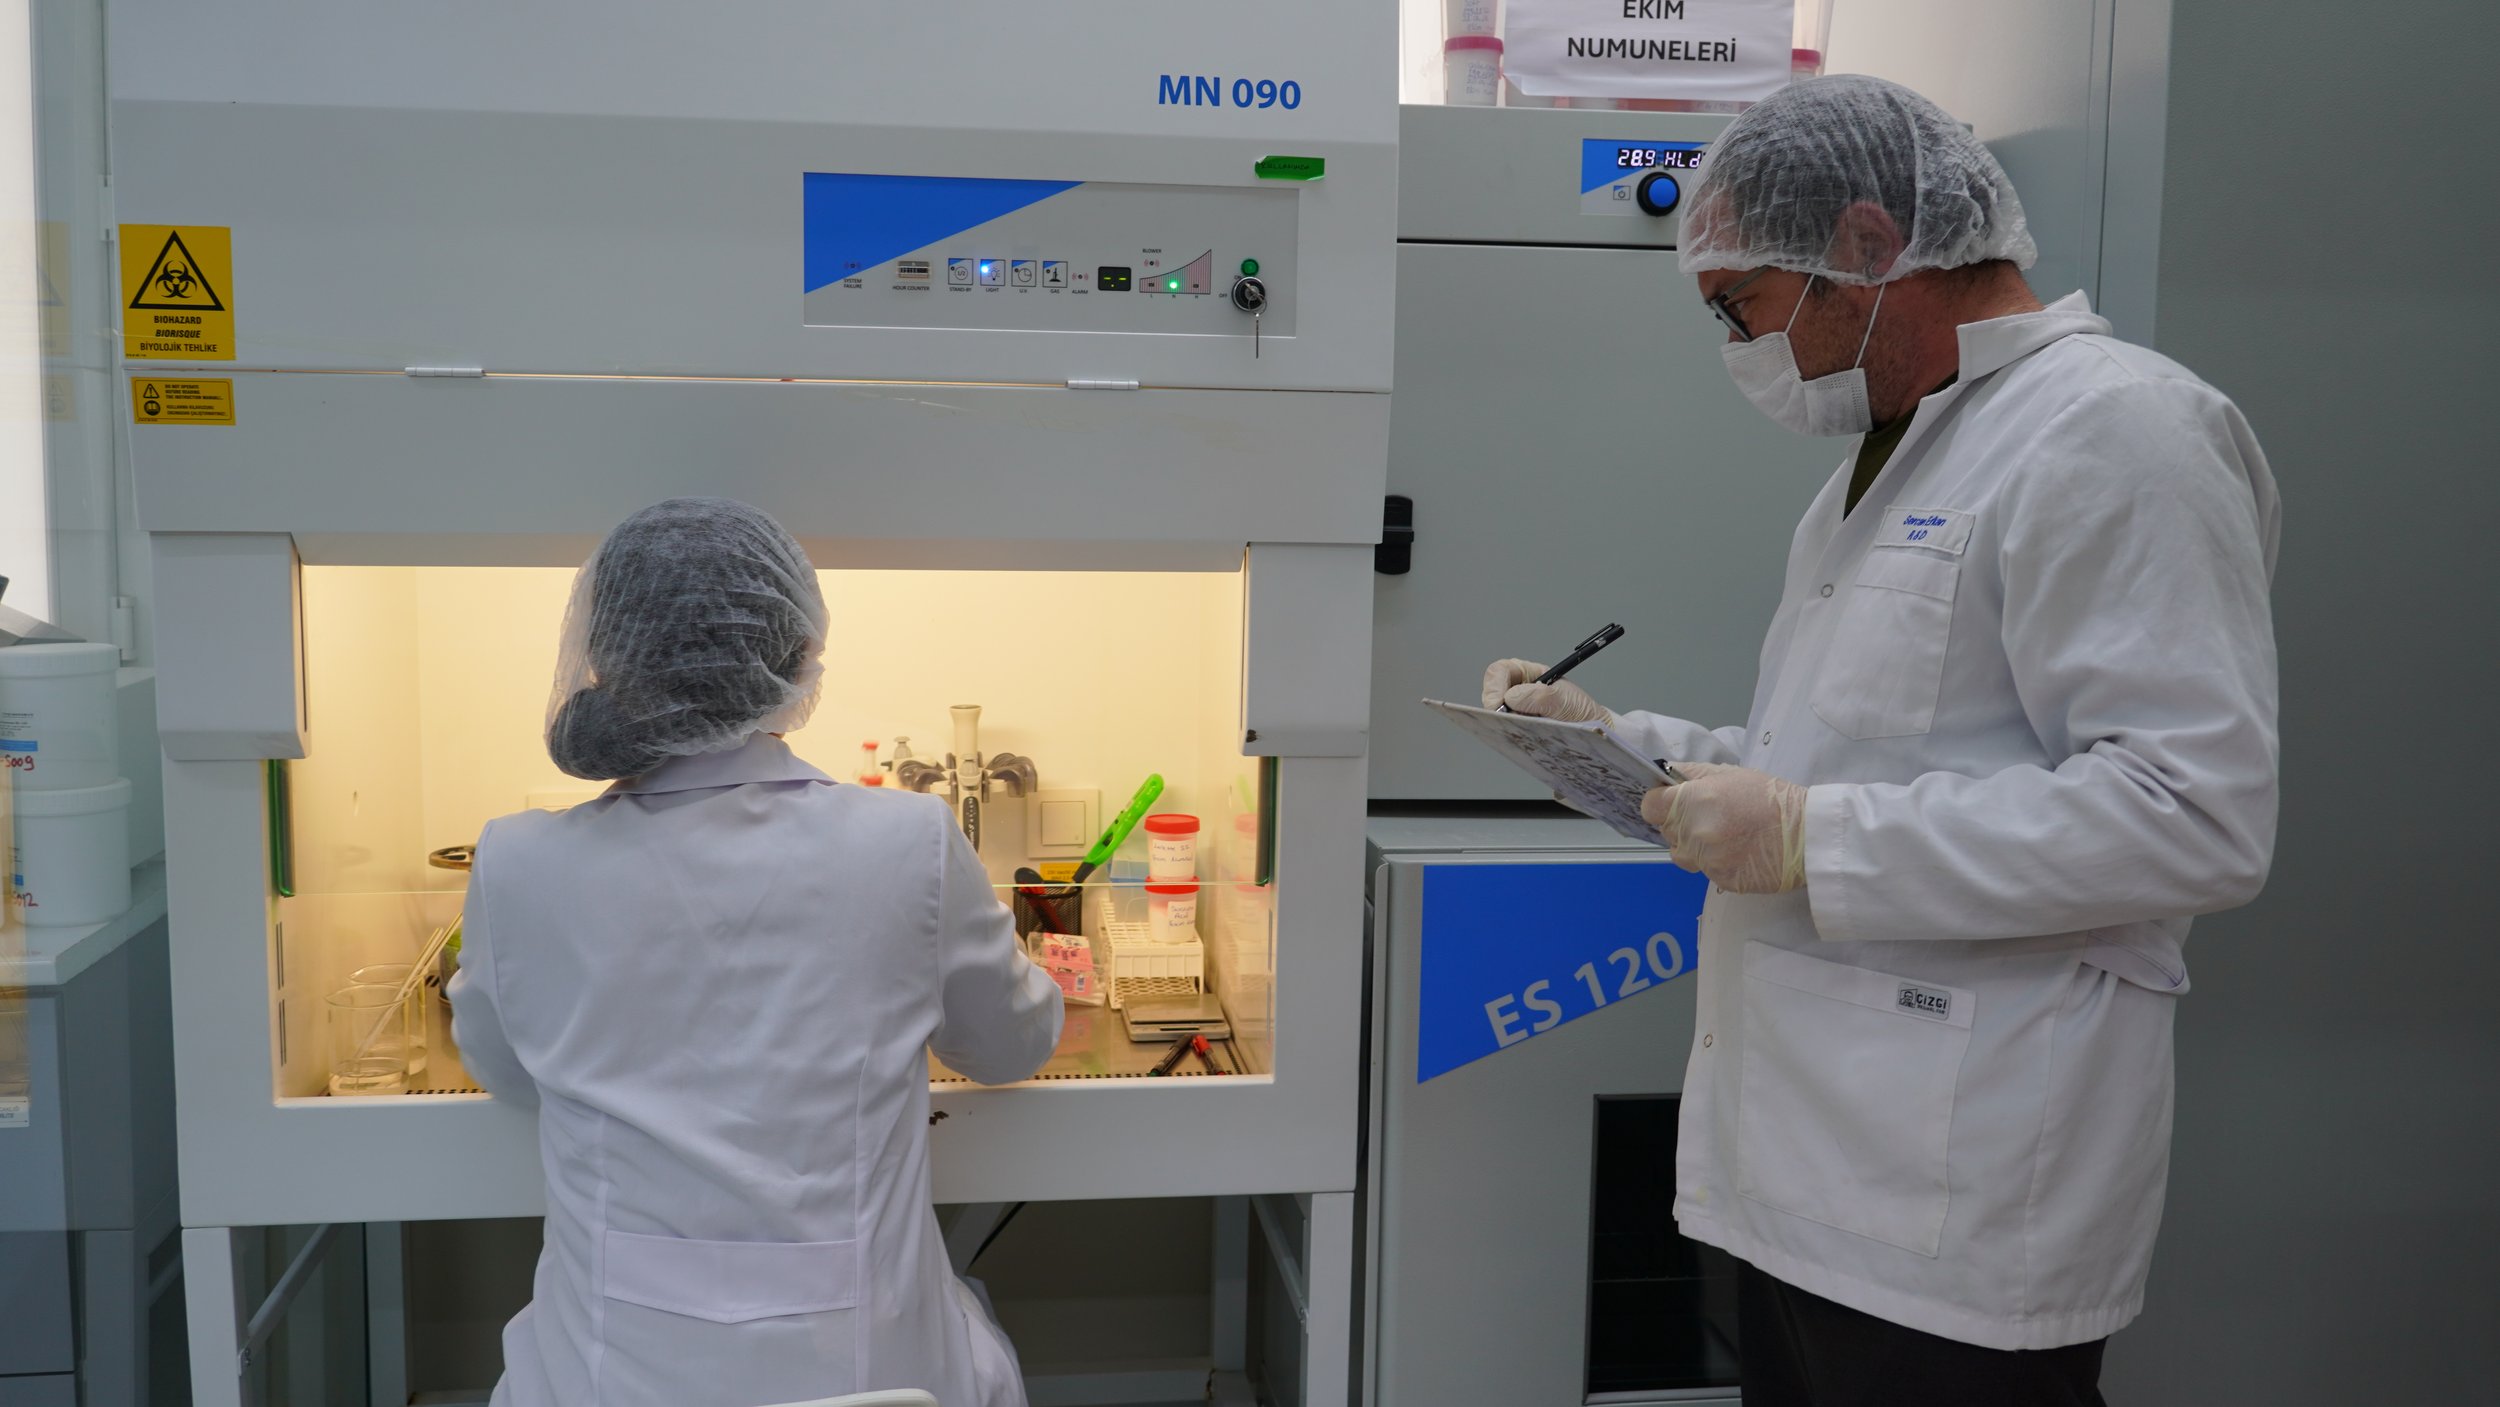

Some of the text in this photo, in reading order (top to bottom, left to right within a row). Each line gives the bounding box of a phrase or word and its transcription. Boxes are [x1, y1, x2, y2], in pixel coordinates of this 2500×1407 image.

[1567, 37, 1736, 62] NUMUNELERİ
[1158, 74, 1301, 110] MN 090
[154, 315, 202, 324] BIOHAZARD
[155, 329, 201, 338] BIORISQUE
[140, 341, 217, 352] BİYOLOJİK TEHLİKE
[1484, 931, 1684, 1049] ES 120
